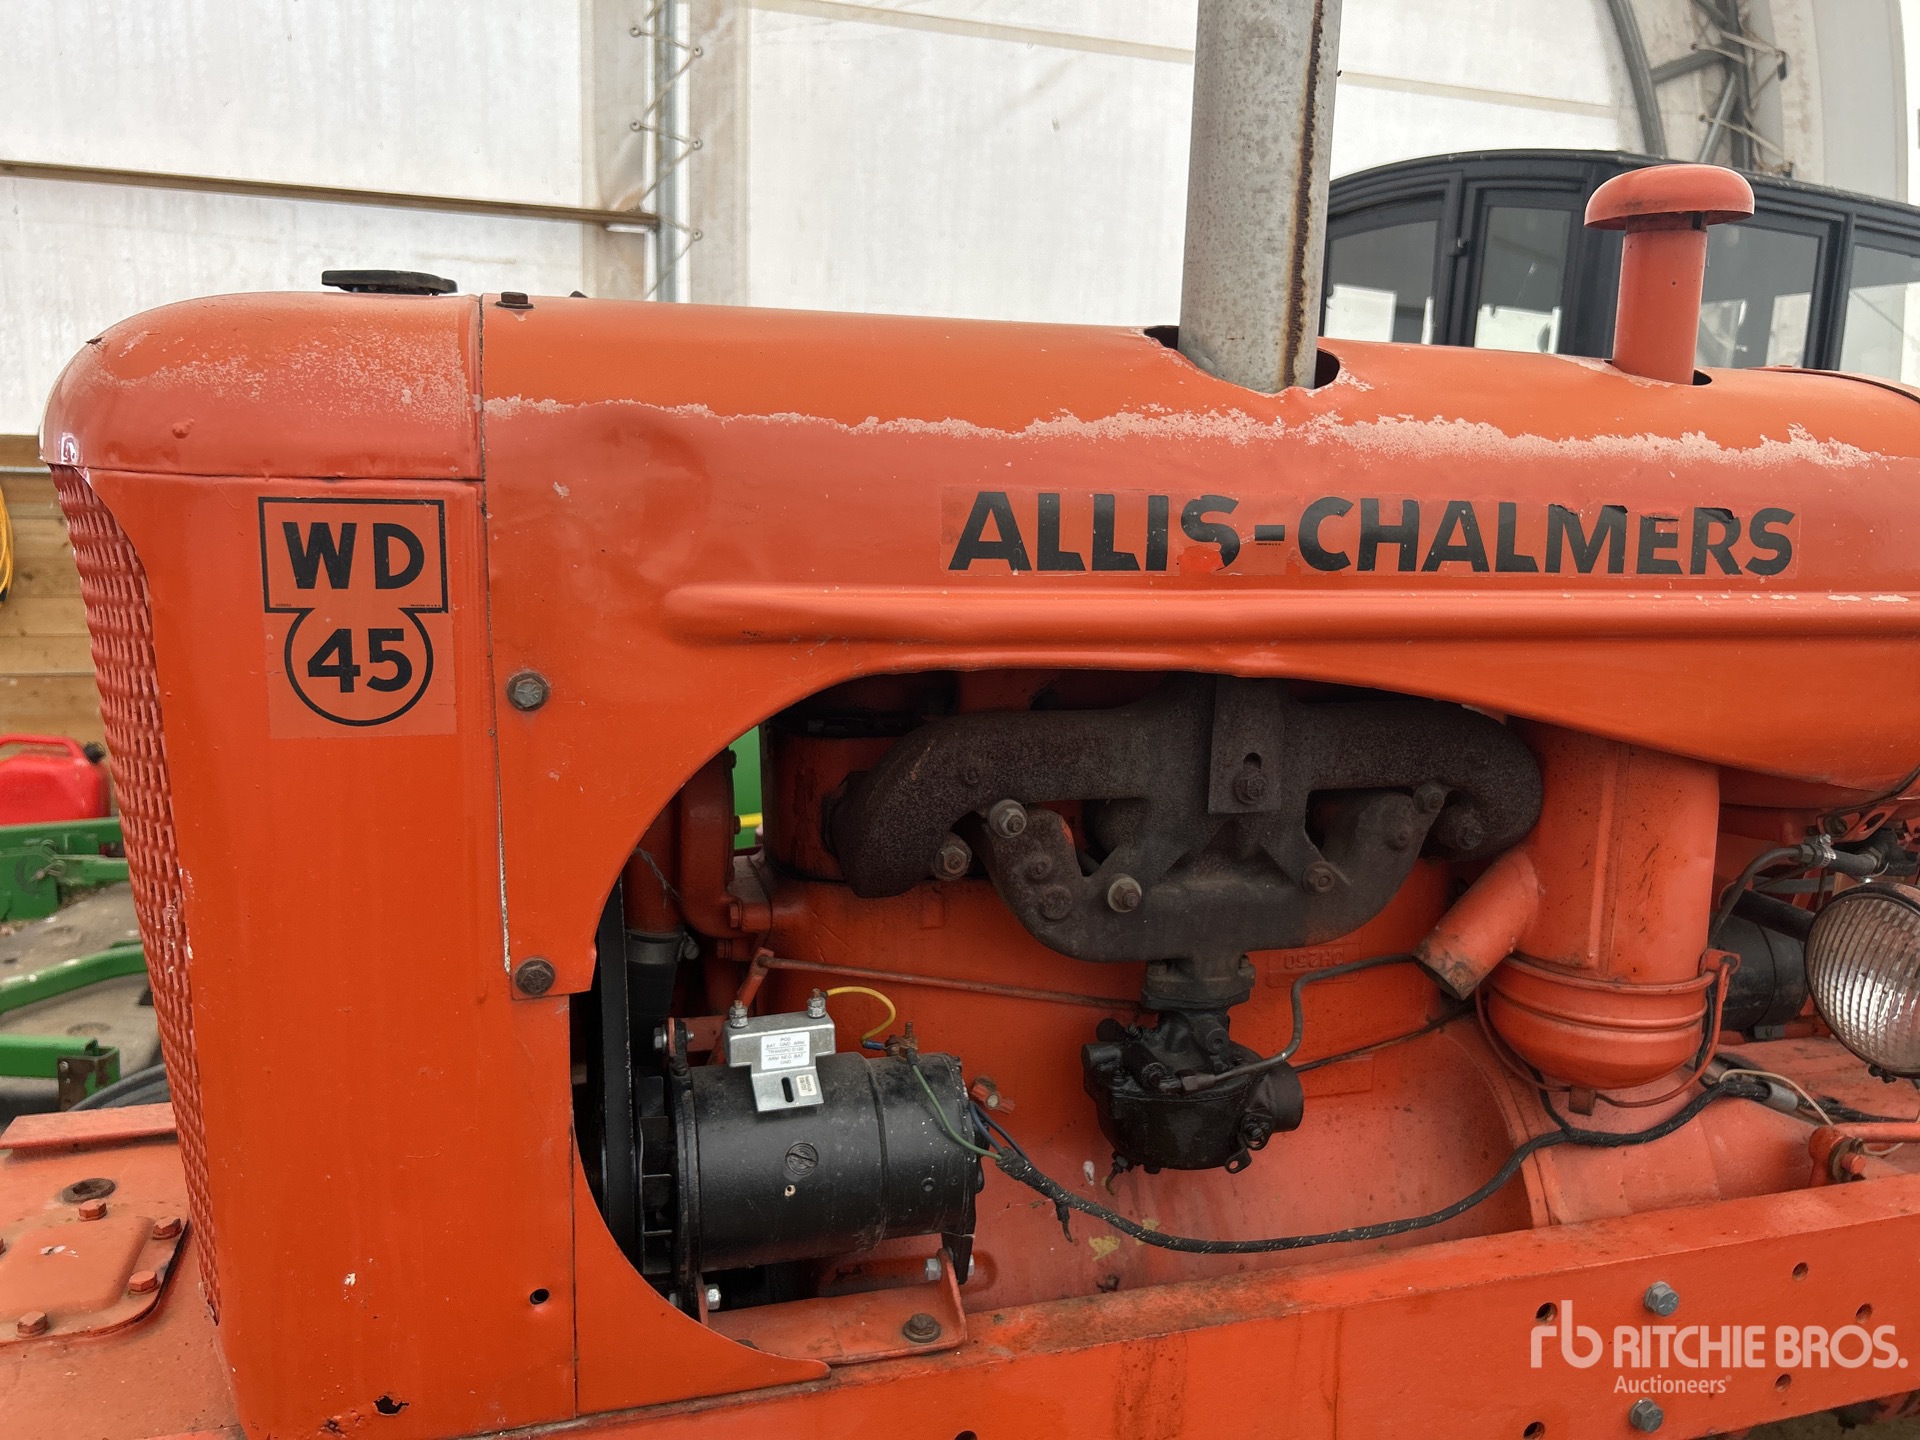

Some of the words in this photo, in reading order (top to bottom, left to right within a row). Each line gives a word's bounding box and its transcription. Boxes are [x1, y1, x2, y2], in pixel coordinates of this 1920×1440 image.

[282, 521, 425, 590] WD
[948, 490, 1796, 578] ALLIS-CHALMERS
[307, 628, 413, 693] 45
